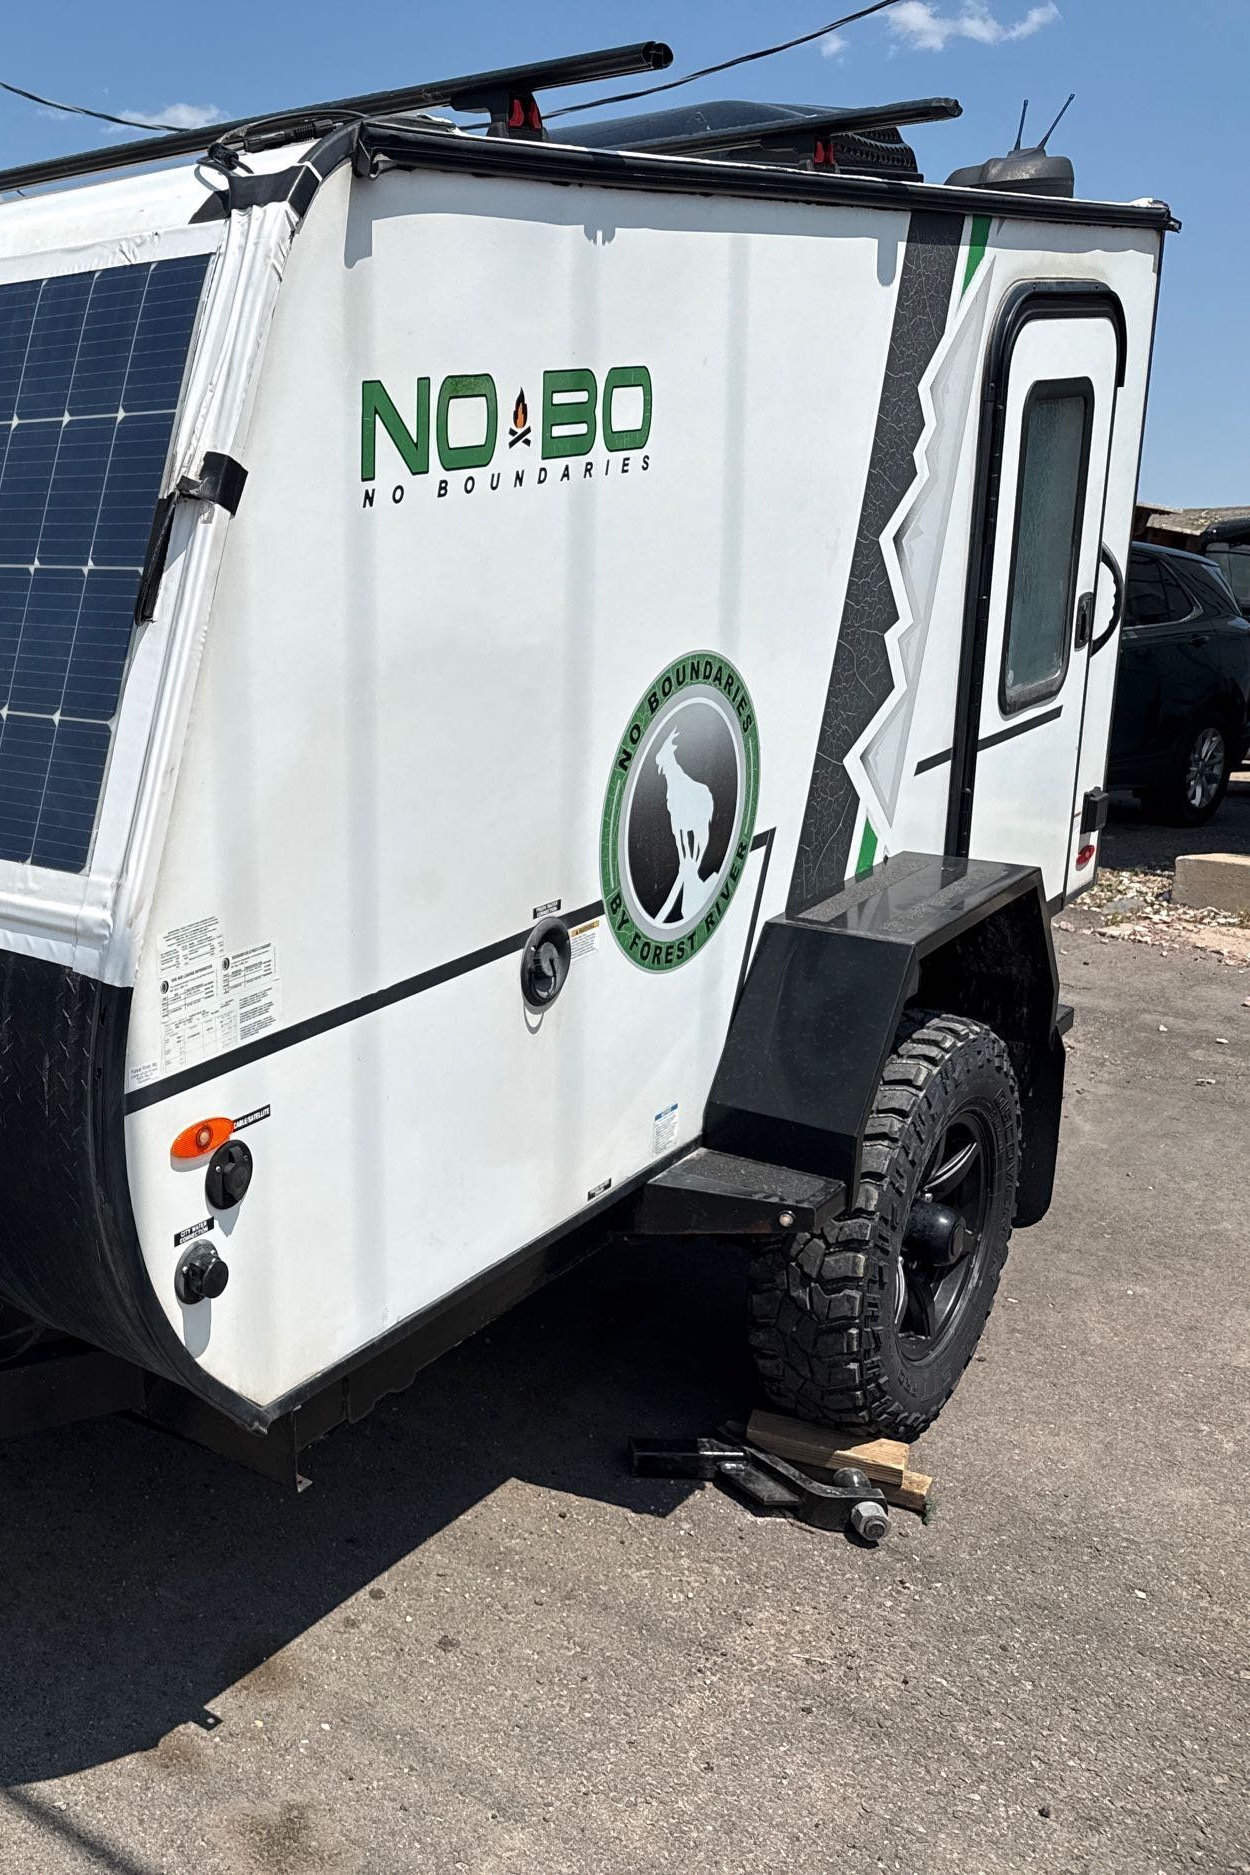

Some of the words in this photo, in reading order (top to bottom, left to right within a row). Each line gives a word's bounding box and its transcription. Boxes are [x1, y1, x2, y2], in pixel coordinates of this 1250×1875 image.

[361, 373, 498, 482] NO
[541, 365, 653, 460] BO
[362, 485, 405, 509] NO
[437, 455, 651, 498] BOUNDARIES
[618, 725, 642, 773] NO
[647, 660, 752, 735] BOUNDARIES
[609, 892, 630, 932] BY
[629, 933, 697, 966] FOREST
[705, 841, 749, 935] RIVER
